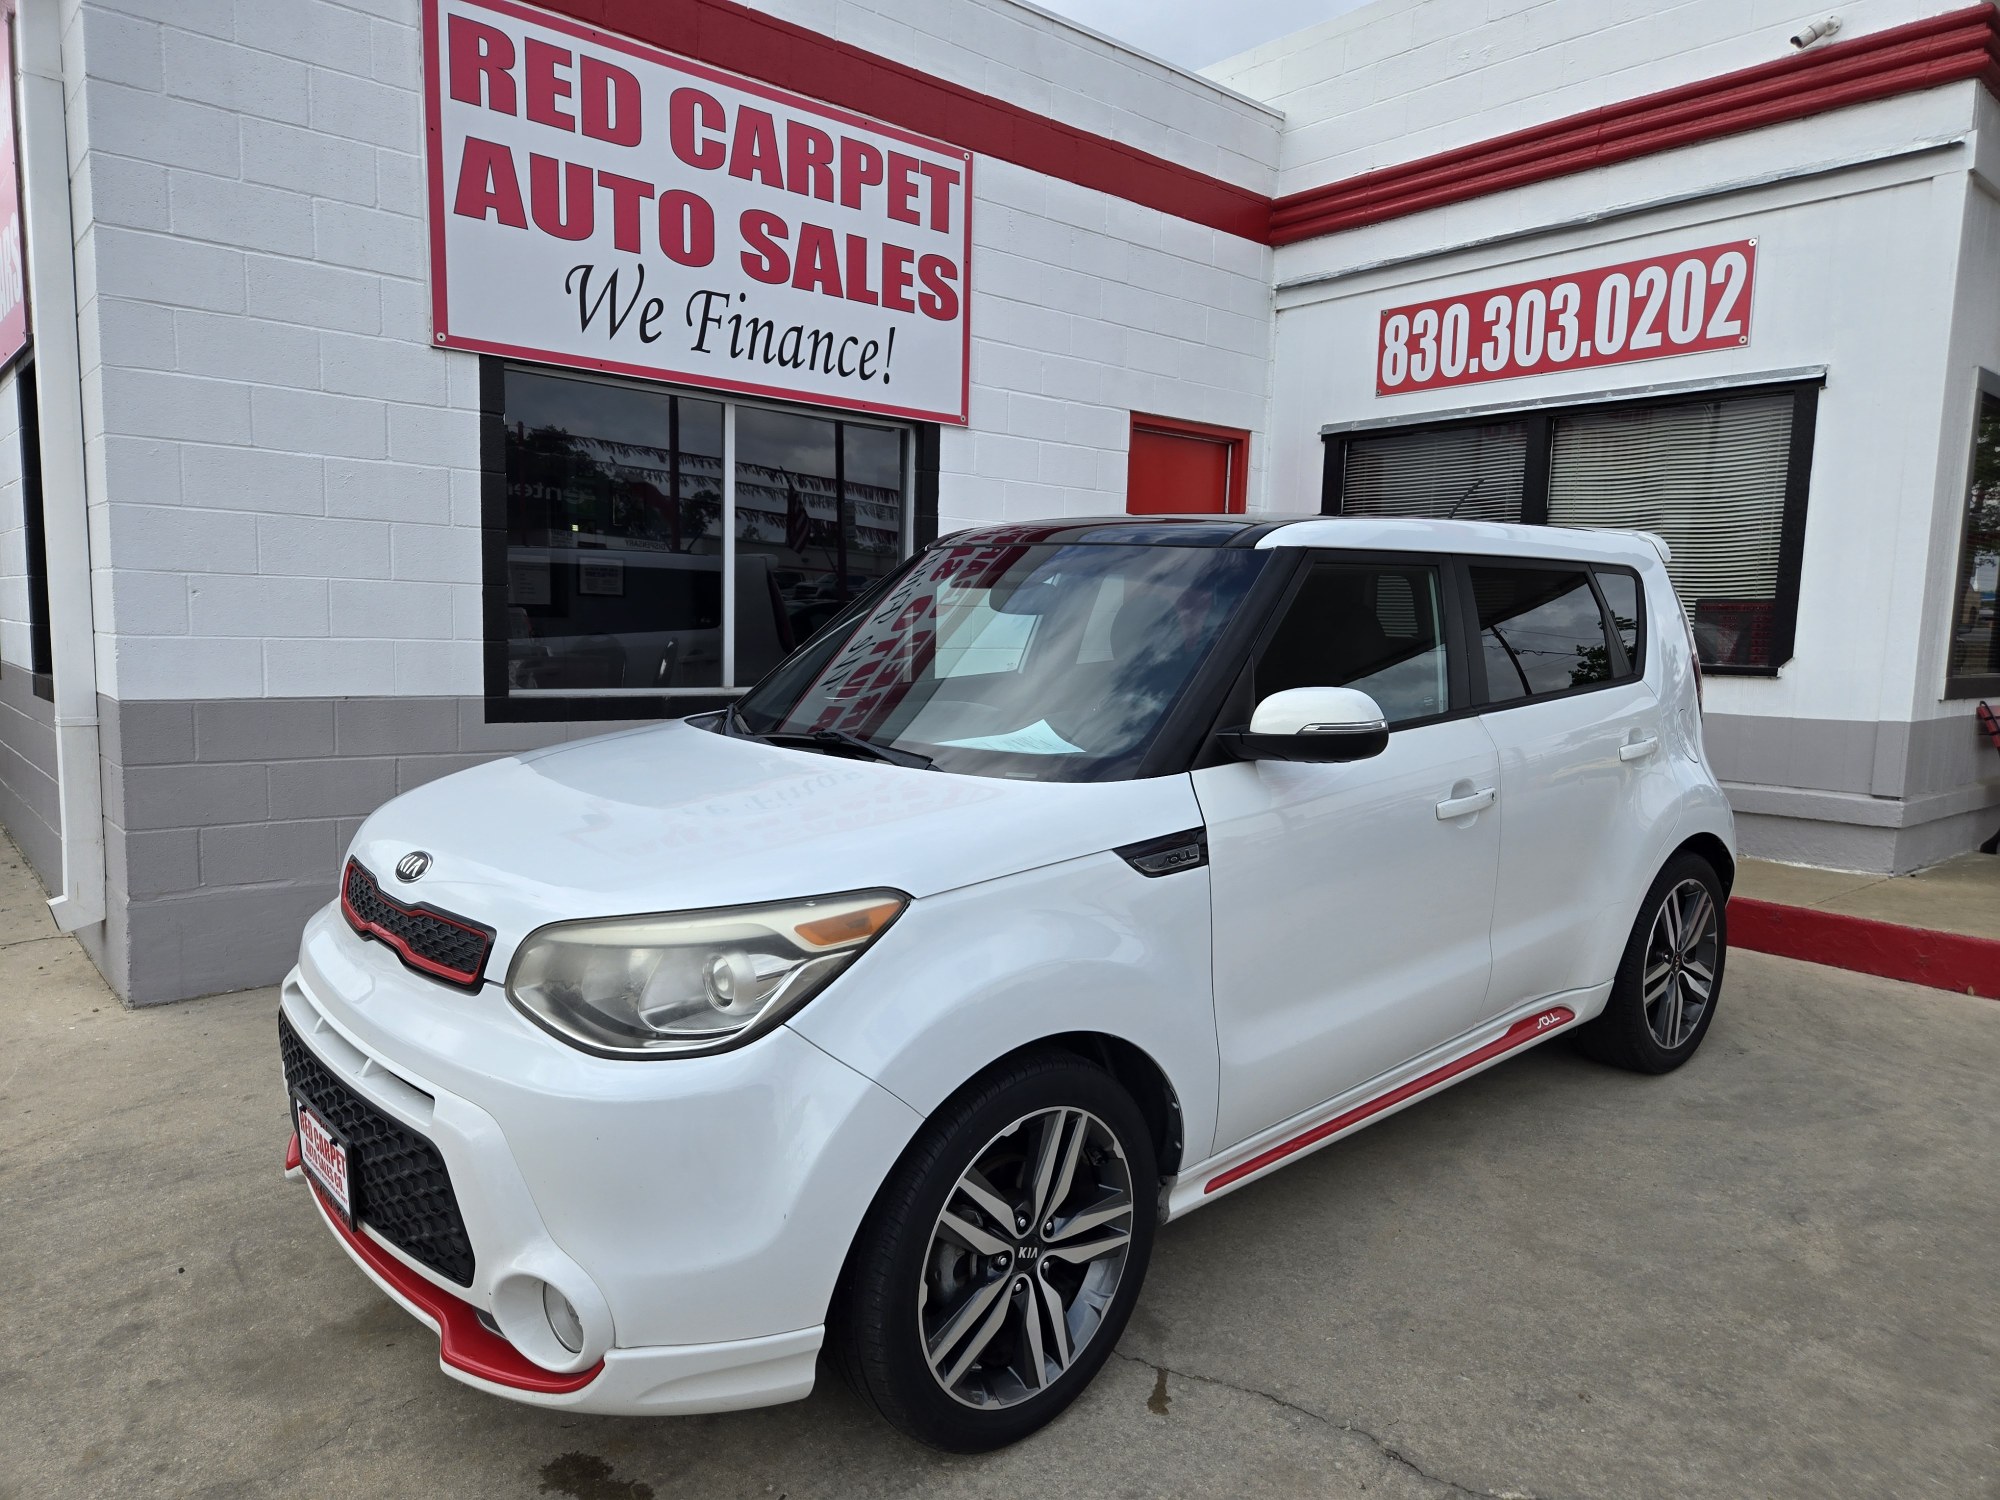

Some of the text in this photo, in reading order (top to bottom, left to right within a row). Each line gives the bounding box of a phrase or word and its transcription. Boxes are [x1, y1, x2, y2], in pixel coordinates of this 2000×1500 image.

[448, 13, 960, 234] RED CARPET
[453, 135, 959, 321] AUTO SALES
[565, 263, 896, 385] We Finance!
[1381, 251, 1748, 387] 830.303.0202
[397, 854, 425, 878] KIA
[300, 1110, 314, 1143] RED
[313, 1126, 347, 1180] CARPET
[1018, 1246, 1038, 1259] KIA
